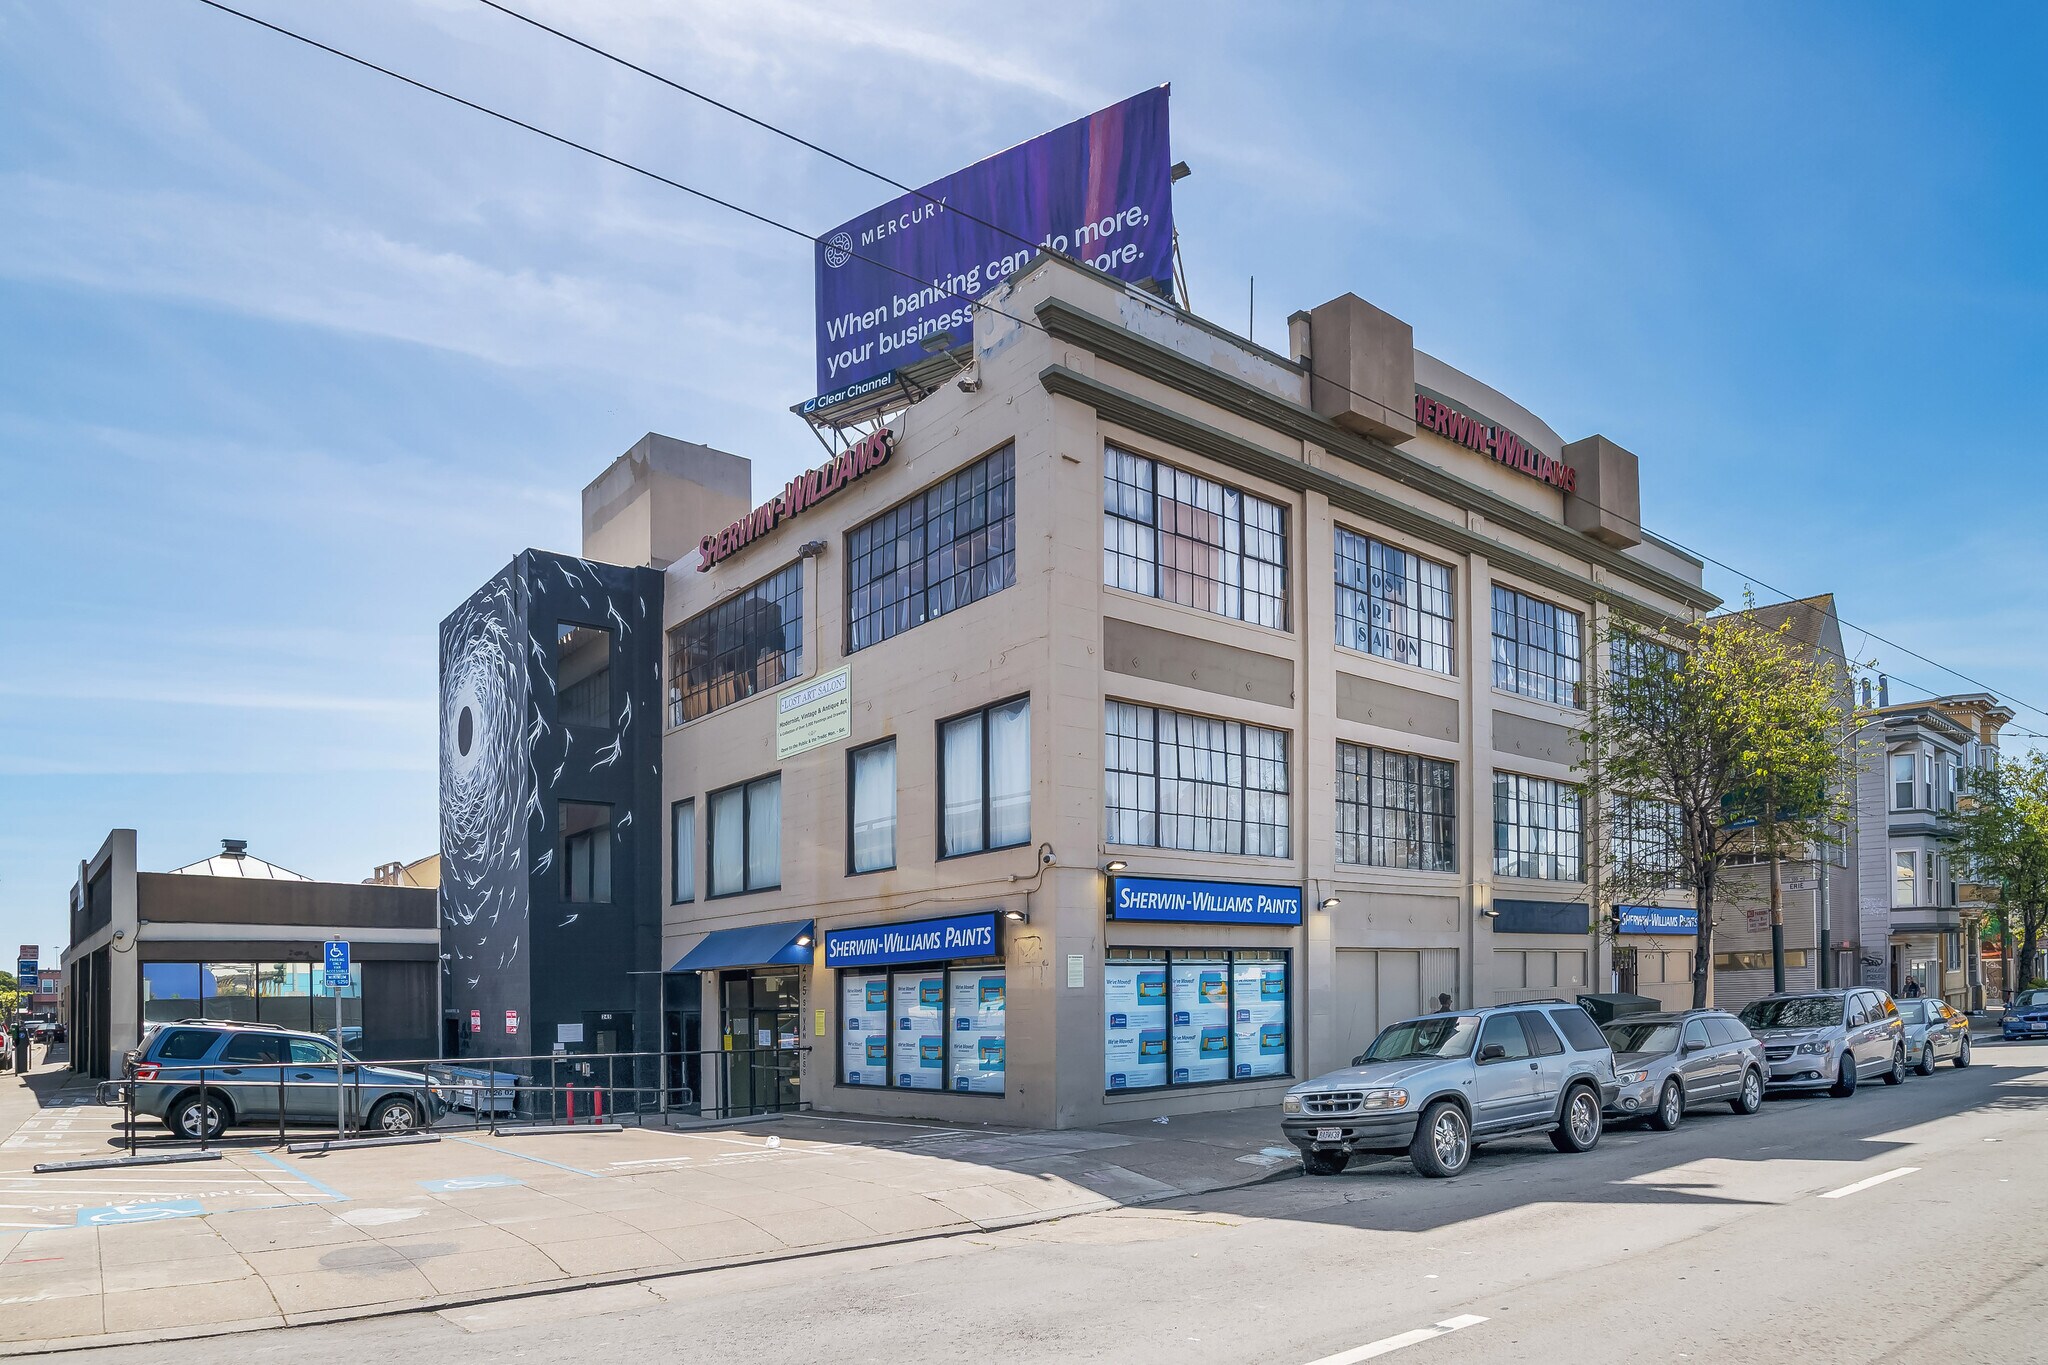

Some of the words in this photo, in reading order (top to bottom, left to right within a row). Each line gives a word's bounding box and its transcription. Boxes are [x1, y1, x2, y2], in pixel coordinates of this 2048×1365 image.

[862, 196, 947, 246] MERCURY
[826, 306, 888, 342] When
[893, 265, 981, 318] banking
[986, 249, 1030, 281] can
[1075, 206, 1150, 248] more,
[827, 341, 874, 378] your
[879, 304, 974, 355] business
[1084, 243, 1145, 272] ore.
[818, 390, 846, 408] Clear
[847, 372, 891, 397] Channel
[1415, 394, 1577, 492] HERWIN-WILLIAMS
[696, 428, 893, 573] SHERWIN-WILLIAMS
[1357, 568, 1404, 596] LOST
[1357, 598, 1393, 623] ART
[1358, 626, 1417, 656] SALON
[784, 694, 801, 709] LOST
[802, 689, 816, 700] ART
[818, 678, 842, 695] SALON
[801, 710, 817, 720] Vintage
[822, 702, 839, 712] Antique
[1119, 887, 1253, 913] SHERWIN-WILLIAMS
[1256, 894, 1298, 914] PAINTS
[830, 932, 940, 958] SHERWIN-WILLIAMS
[945, 926, 992, 948] PAINTS
